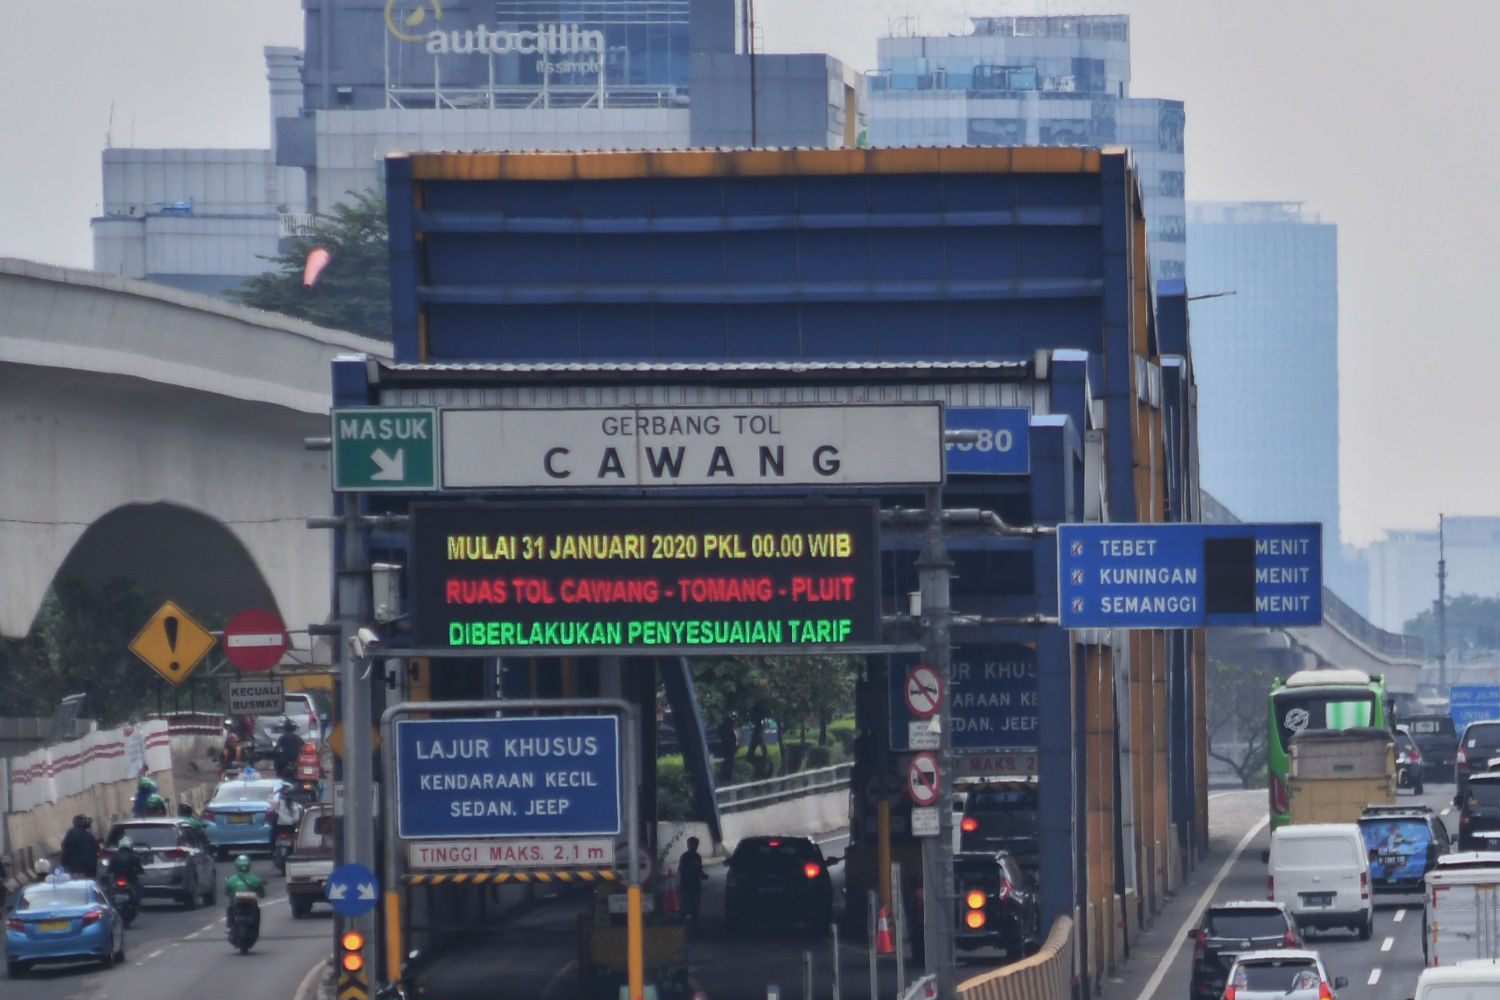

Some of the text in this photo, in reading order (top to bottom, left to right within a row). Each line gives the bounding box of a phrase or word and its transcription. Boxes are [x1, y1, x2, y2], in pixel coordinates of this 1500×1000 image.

[425, 23, 605, 54] autocillin
[339, 418, 427, 441] MASUK
[601, 415, 781, 437] GERBANG TOL
[542, 444, 841, 479] CAWANG
[447, 533, 851, 560] MULAI 31 JANUARI 2020 PKL 00.00 WIB
[1100, 538, 1309, 557] TEBET MENIT
[1100, 567, 1309, 585] KUNINGAN MENIT
[446, 579, 507, 604] RUAS
[513, 579, 555, 603] TOL
[560, 579, 659, 603] CAWANG
[678, 578, 773, 602] TOMANG
[792, 577, 855, 601] PLUIT
[1100, 596, 1310, 613] SEMANGGI MENIT
[449, 619, 851, 646] DIBERLAKUKAN PENYESUAIAN TARIF
[231, 687, 280, 696] KECUALI
[232, 700, 278, 709] BUSWAY
[416, 736, 597, 760] LAJUR KHUSUS
[420, 771, 597, 790] KENDARAAN KECIL
[525, 799, 569, 815] JEEP
[420, 847, 478, 862] TINGGI
[489, 846, 544, 861] MAKS.
[587, 846, 604, 859] m
